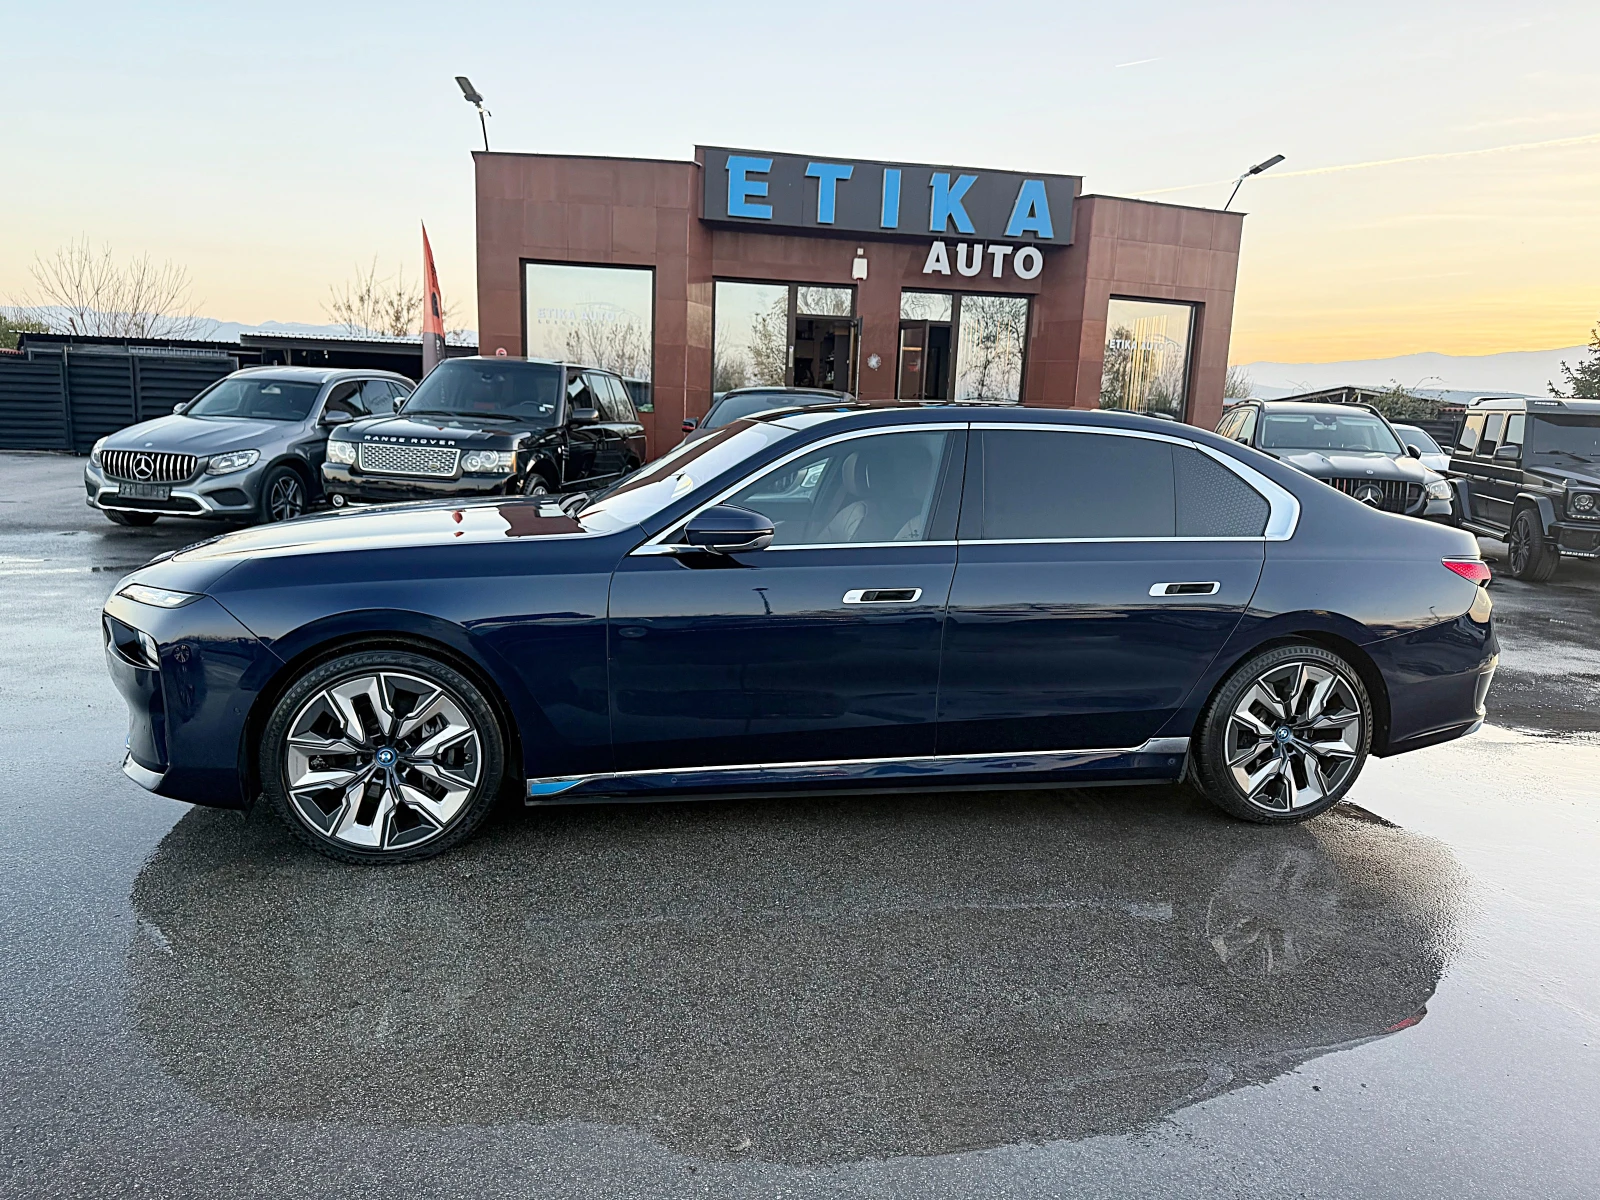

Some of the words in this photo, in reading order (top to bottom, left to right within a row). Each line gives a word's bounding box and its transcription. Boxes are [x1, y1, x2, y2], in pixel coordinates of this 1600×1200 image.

[725, 155, 1054, 239] ETIKA
[922, 240, 1044, 280] AUTO
[1109, 339, 1138, 350] ETIKA
[364, 435, 406, 443] RANGE
[411, 438, 456, 446] ROVER
